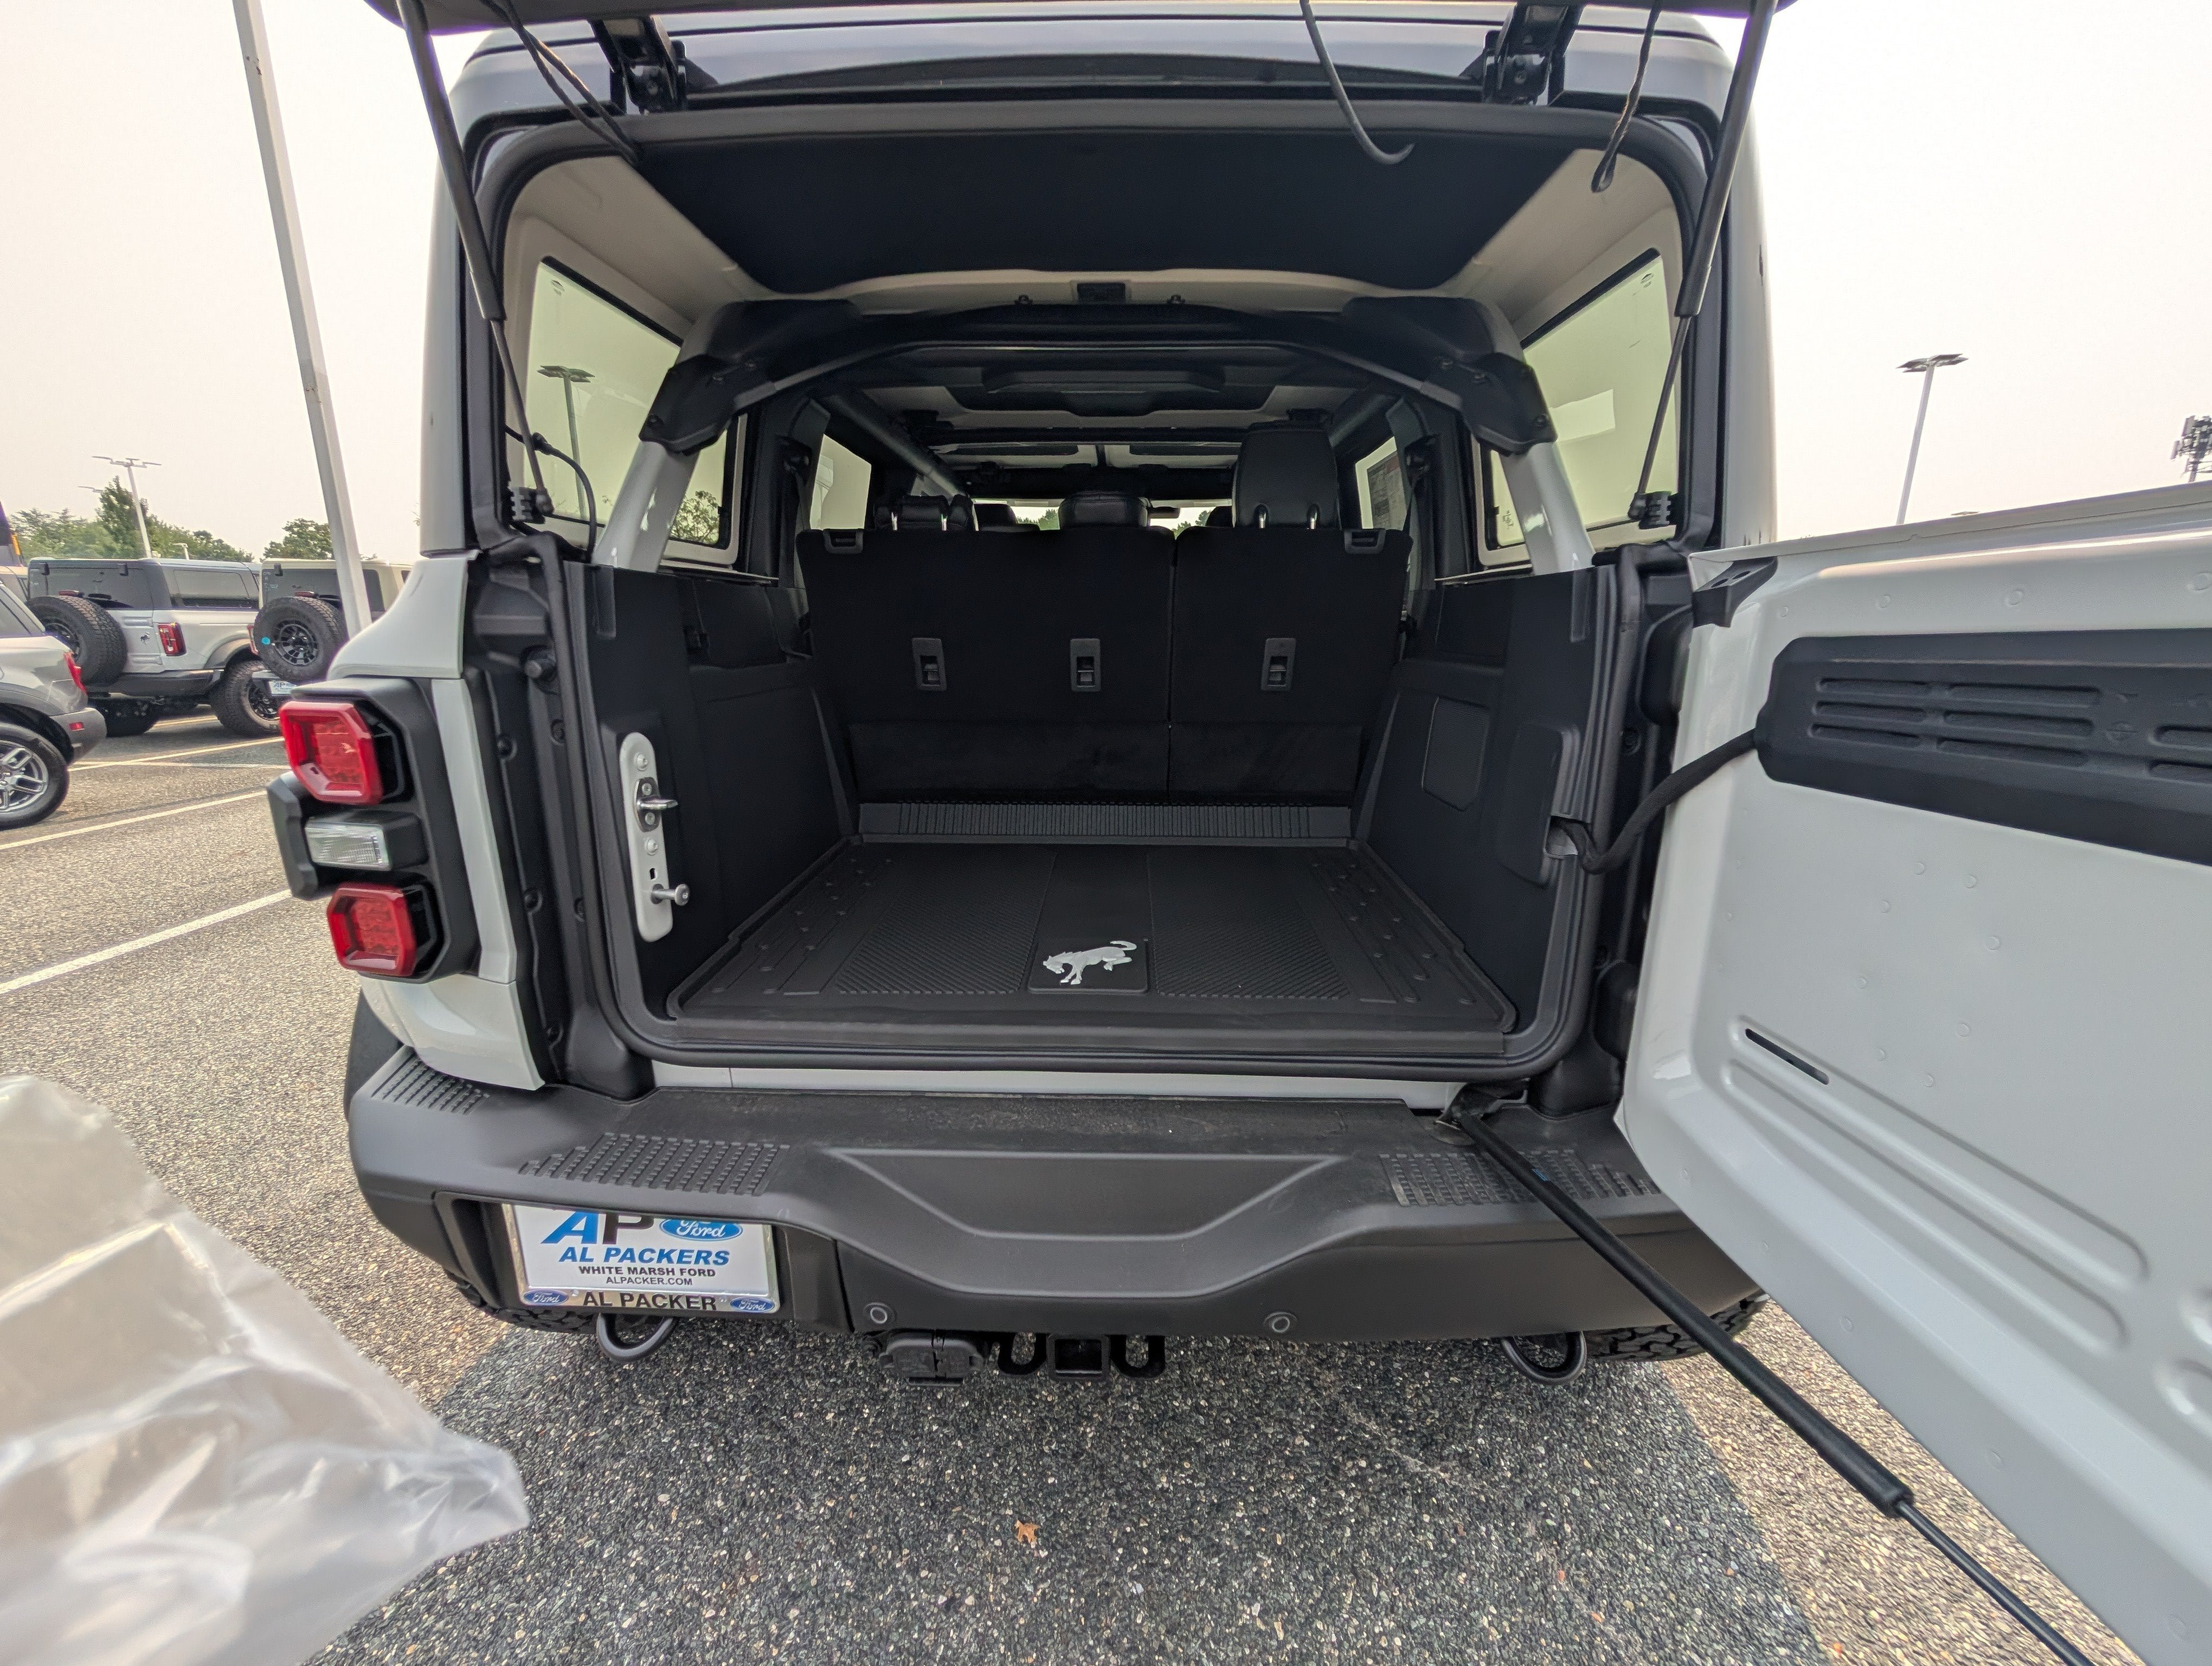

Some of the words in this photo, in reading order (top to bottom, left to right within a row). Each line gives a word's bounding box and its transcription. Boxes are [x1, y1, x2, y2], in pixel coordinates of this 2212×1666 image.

[541, 1211, 654, 1245] AP
[676, 1220, 726, 1237] Ford
[558, 1247, 594, 1263] AL
[603, 1247, 730, 1266] PACKERS
[578, 1266, 623, 1275] WHITE
[627, 1266, 676, 1276] MARSH
[679, 1268, 716, 1277] FORD
[606, 1276, 693, 1286] ALPACKER.COM
[532, 1291, 561, 1303] Ford
[582, 1291, 613, 1306] AL
[619, 1292, 717, 1311] PACKER
[737, 1299, 767, 1310] Ford
